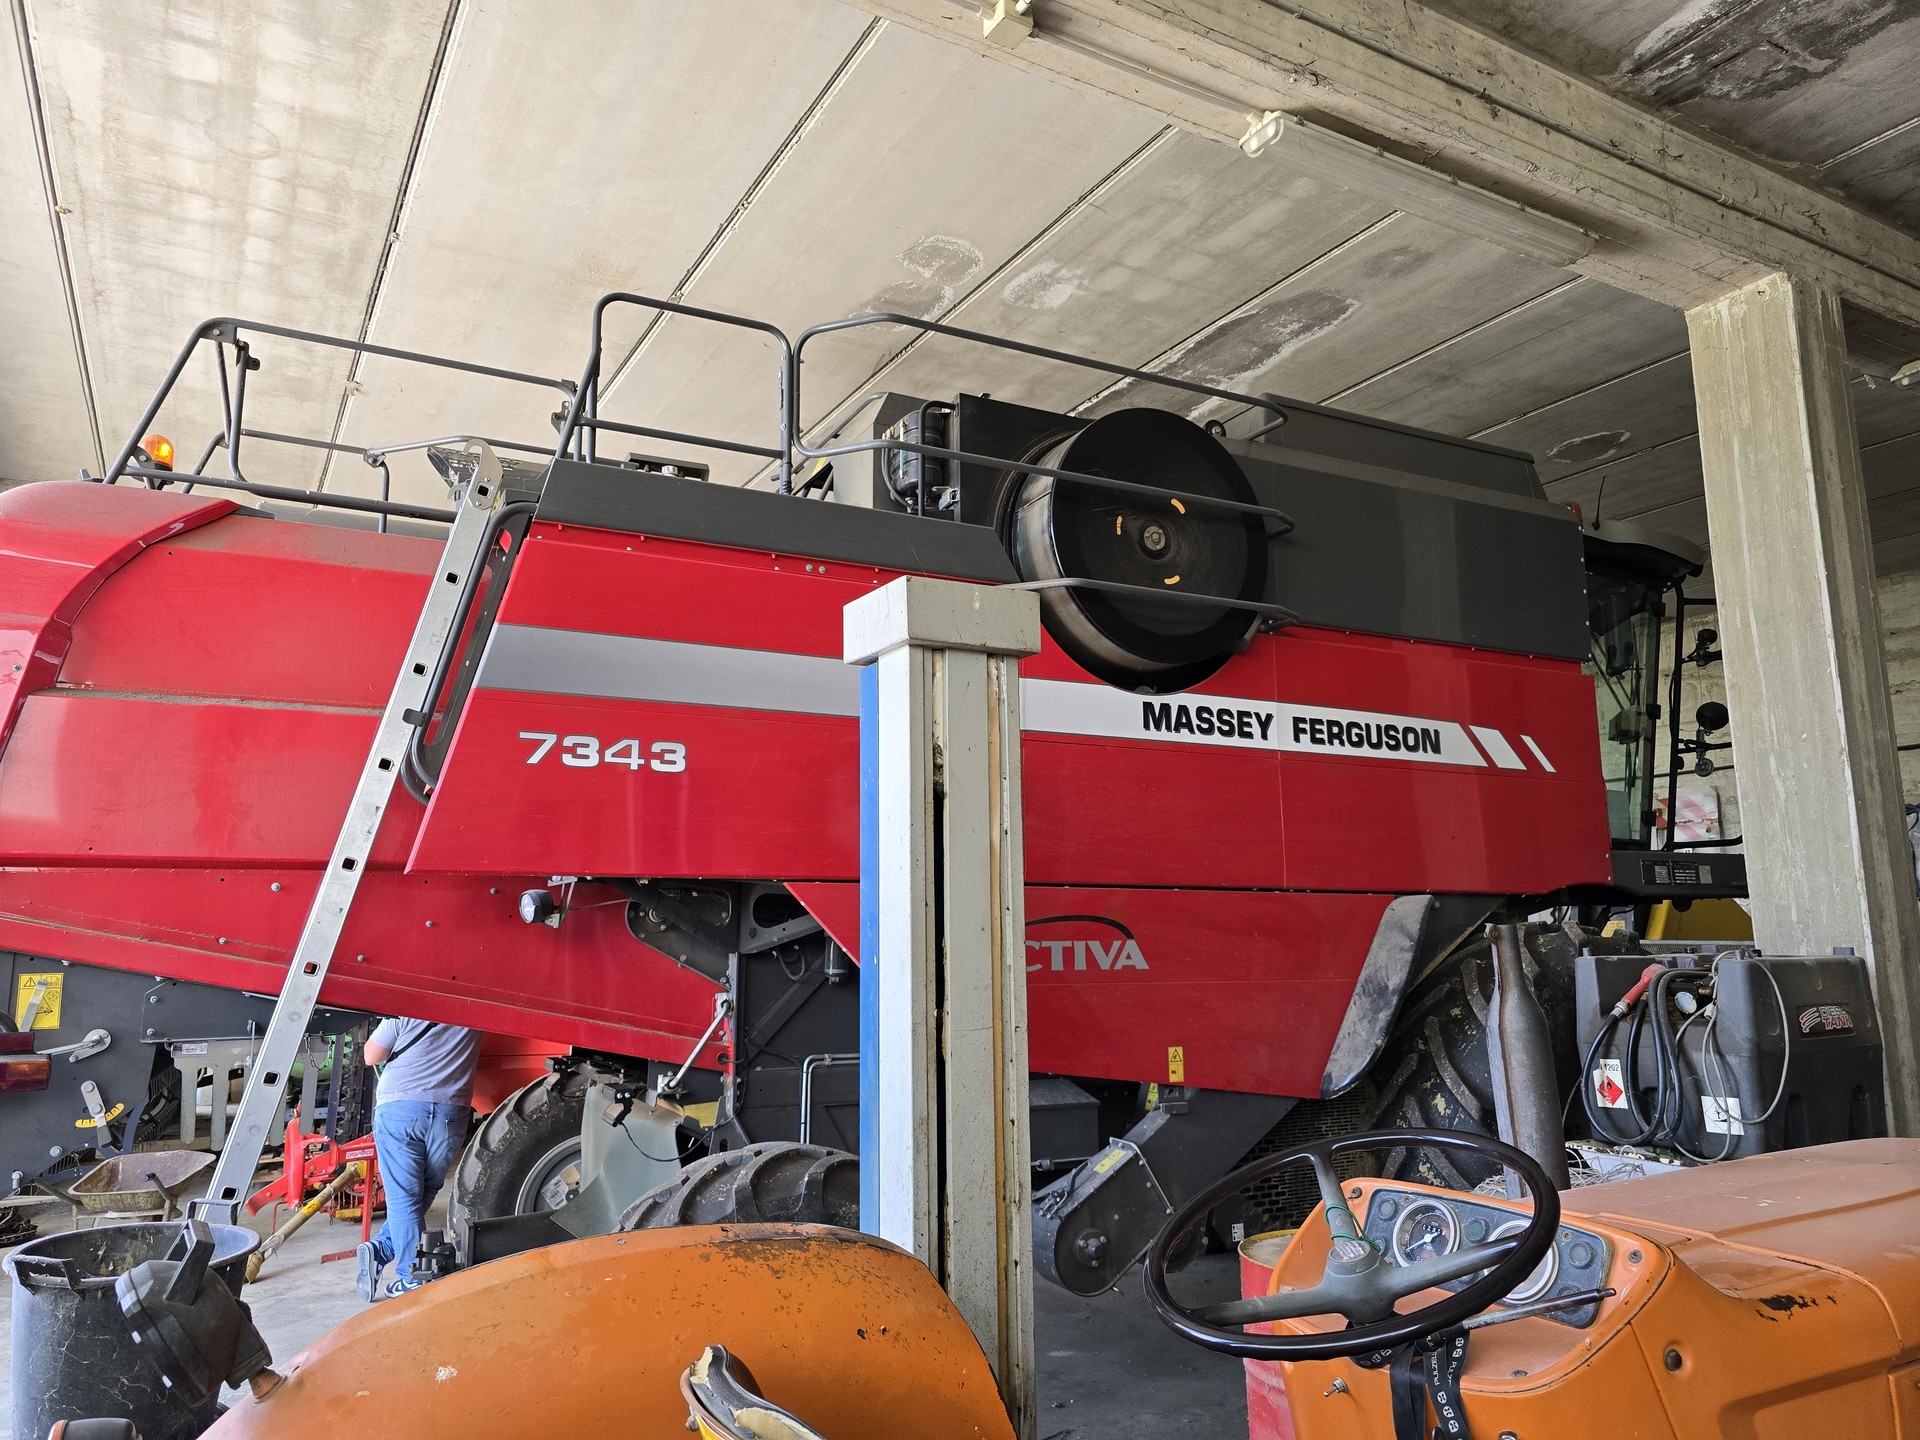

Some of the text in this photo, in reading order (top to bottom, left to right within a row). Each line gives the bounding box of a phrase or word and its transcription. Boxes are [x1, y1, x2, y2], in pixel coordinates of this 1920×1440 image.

[1142, 701, 1442, 755] MASSEY FERGUSON
[518, 731, 687, 773] 7343
[1025, 939, 1151, 972] CTIVA
